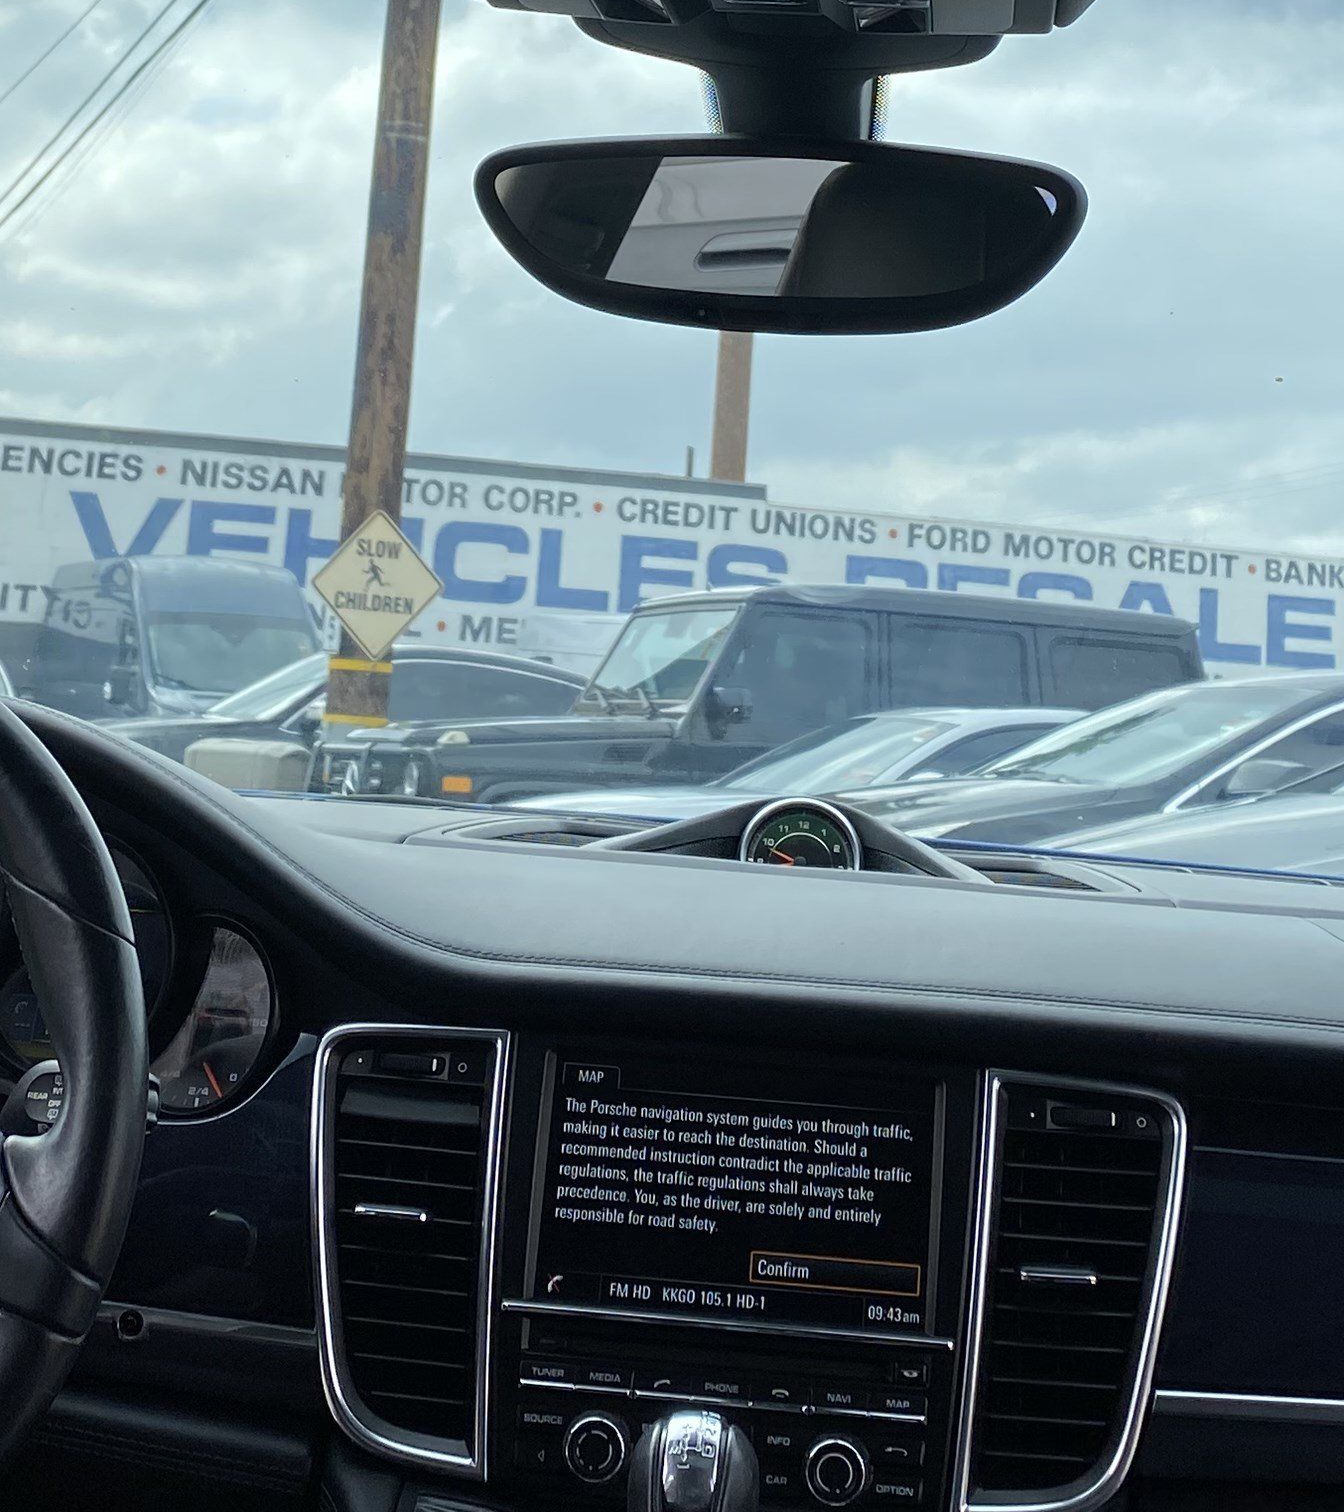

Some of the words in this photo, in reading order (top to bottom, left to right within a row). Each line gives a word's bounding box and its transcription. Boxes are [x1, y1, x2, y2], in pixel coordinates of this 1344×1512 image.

[180, 458, 325, 497] NISSAN
[482, 484, 583, 519] CORP.
[617, 496, 738, 532] CREDIT
[751, 507, 877, 545] UNIONS
[907, 522, 991, 554] FORD
[1004, 532, 1117, 567] MOTOR
[1128, 545, 1239, 579] CREDIT
[356, 537, 403, 559] SLOW
[333, 590, 414, 615] CHILDREN
[778, 824, 789, 834] 11
[798, 820, 810, 830] 12
[821, 828, 827, 836] 1
[762, 837, 775, 847] 10
[833, 844, 841, 853] 2
[578, 1070, 604, 1083] MAP
[27, 1091, 48, 1101] REAR
[566, 1098, 586, 1113] The
[591, 1100, 637, 1117] Porsche
[641, 1106, 703, 1123] navigation
[707, 1111, 749, 1128] system
[753, 1114, 792, 1131] guides
[797, 1118, 817, 1134] you
[822, 1119, 869, 1136] through
[873, 1124, 913, 1142] traffic,
[563, 1121, 607, 1138] making
[611, 1124, 619, 1137] it
[623, 1124, 658, 1140] easier
[663, 1128, 674, 1142] to
[679, 1129, 712, 1145] reach
[716, 1131, 735, 1146] the
[739, 1133, 810, 1153] destination.
[814, 1138, 856, 1156] Should
[861, 1147, 867, 1158] a
[561, 1142, 646, 1160] recommended
[650, 1146, 715, 1166] instruction
[719, 1152, 779, 1172] contradict
[784, 1158, 802, 1173] the
[807, 1160, 870, 1180] applicable
[874, 1166, 912, 1183] traffic
[559, 1162, 629, 1182] regulations,
[634, 1168, 652, 1183] the
[657, 1169, 694, 1186] traffic
[698, 1172, 765, 1192] regulations
[769, 1178, 798, 1194] shall
[802, 1181, 844, 1200] always
[848, 1186, 874, 1202] take
[557, 1184, 630, 1203] precedence.
[635, 1190, 659, 1206] You,
[663, 1195, 677, 1206] as
[681, 1193, 700, 1209] the
[704, 1195, 742, 1213] driver,
[746, 1201, 765, 1214] are
[769, 1201, 804, 1220] solely
[809, 1203, 831, 1220] and
[835, 1207, 881, 1226] entirely
[555, 1205, 624, 1224] responsible
[628, 1209, 644, 1225] for
[648, 1211, 674, 1228] road
[679, 1213, 718, 1234] safety.
[758, 1260, 809, 1279] Confirm
[610, 1283, 628, 1298] FM
[633, 1285, 650, 1300] HD
[663, 1288, 695, 1303] KKGO
[701, 1291, 732, 1307] 105.1
[736, 1293, 765, 1311] HD-1
[531, 1367, 565, 1378] TUNER
[589, 1372, 621, 1383] MEDIA
[705, 1383, 739, 1394] PHONE
[826, 1392, 852, 1404] NAVI
[885, 1399, 910, 1409] MAP
[523, 1412, 563, 1425] SOURCE
[766, 1436, 791, 1446] INFO
[765, 1475, 788, 1486] CAR
[875, 1484, 914, 1496] OPTION
